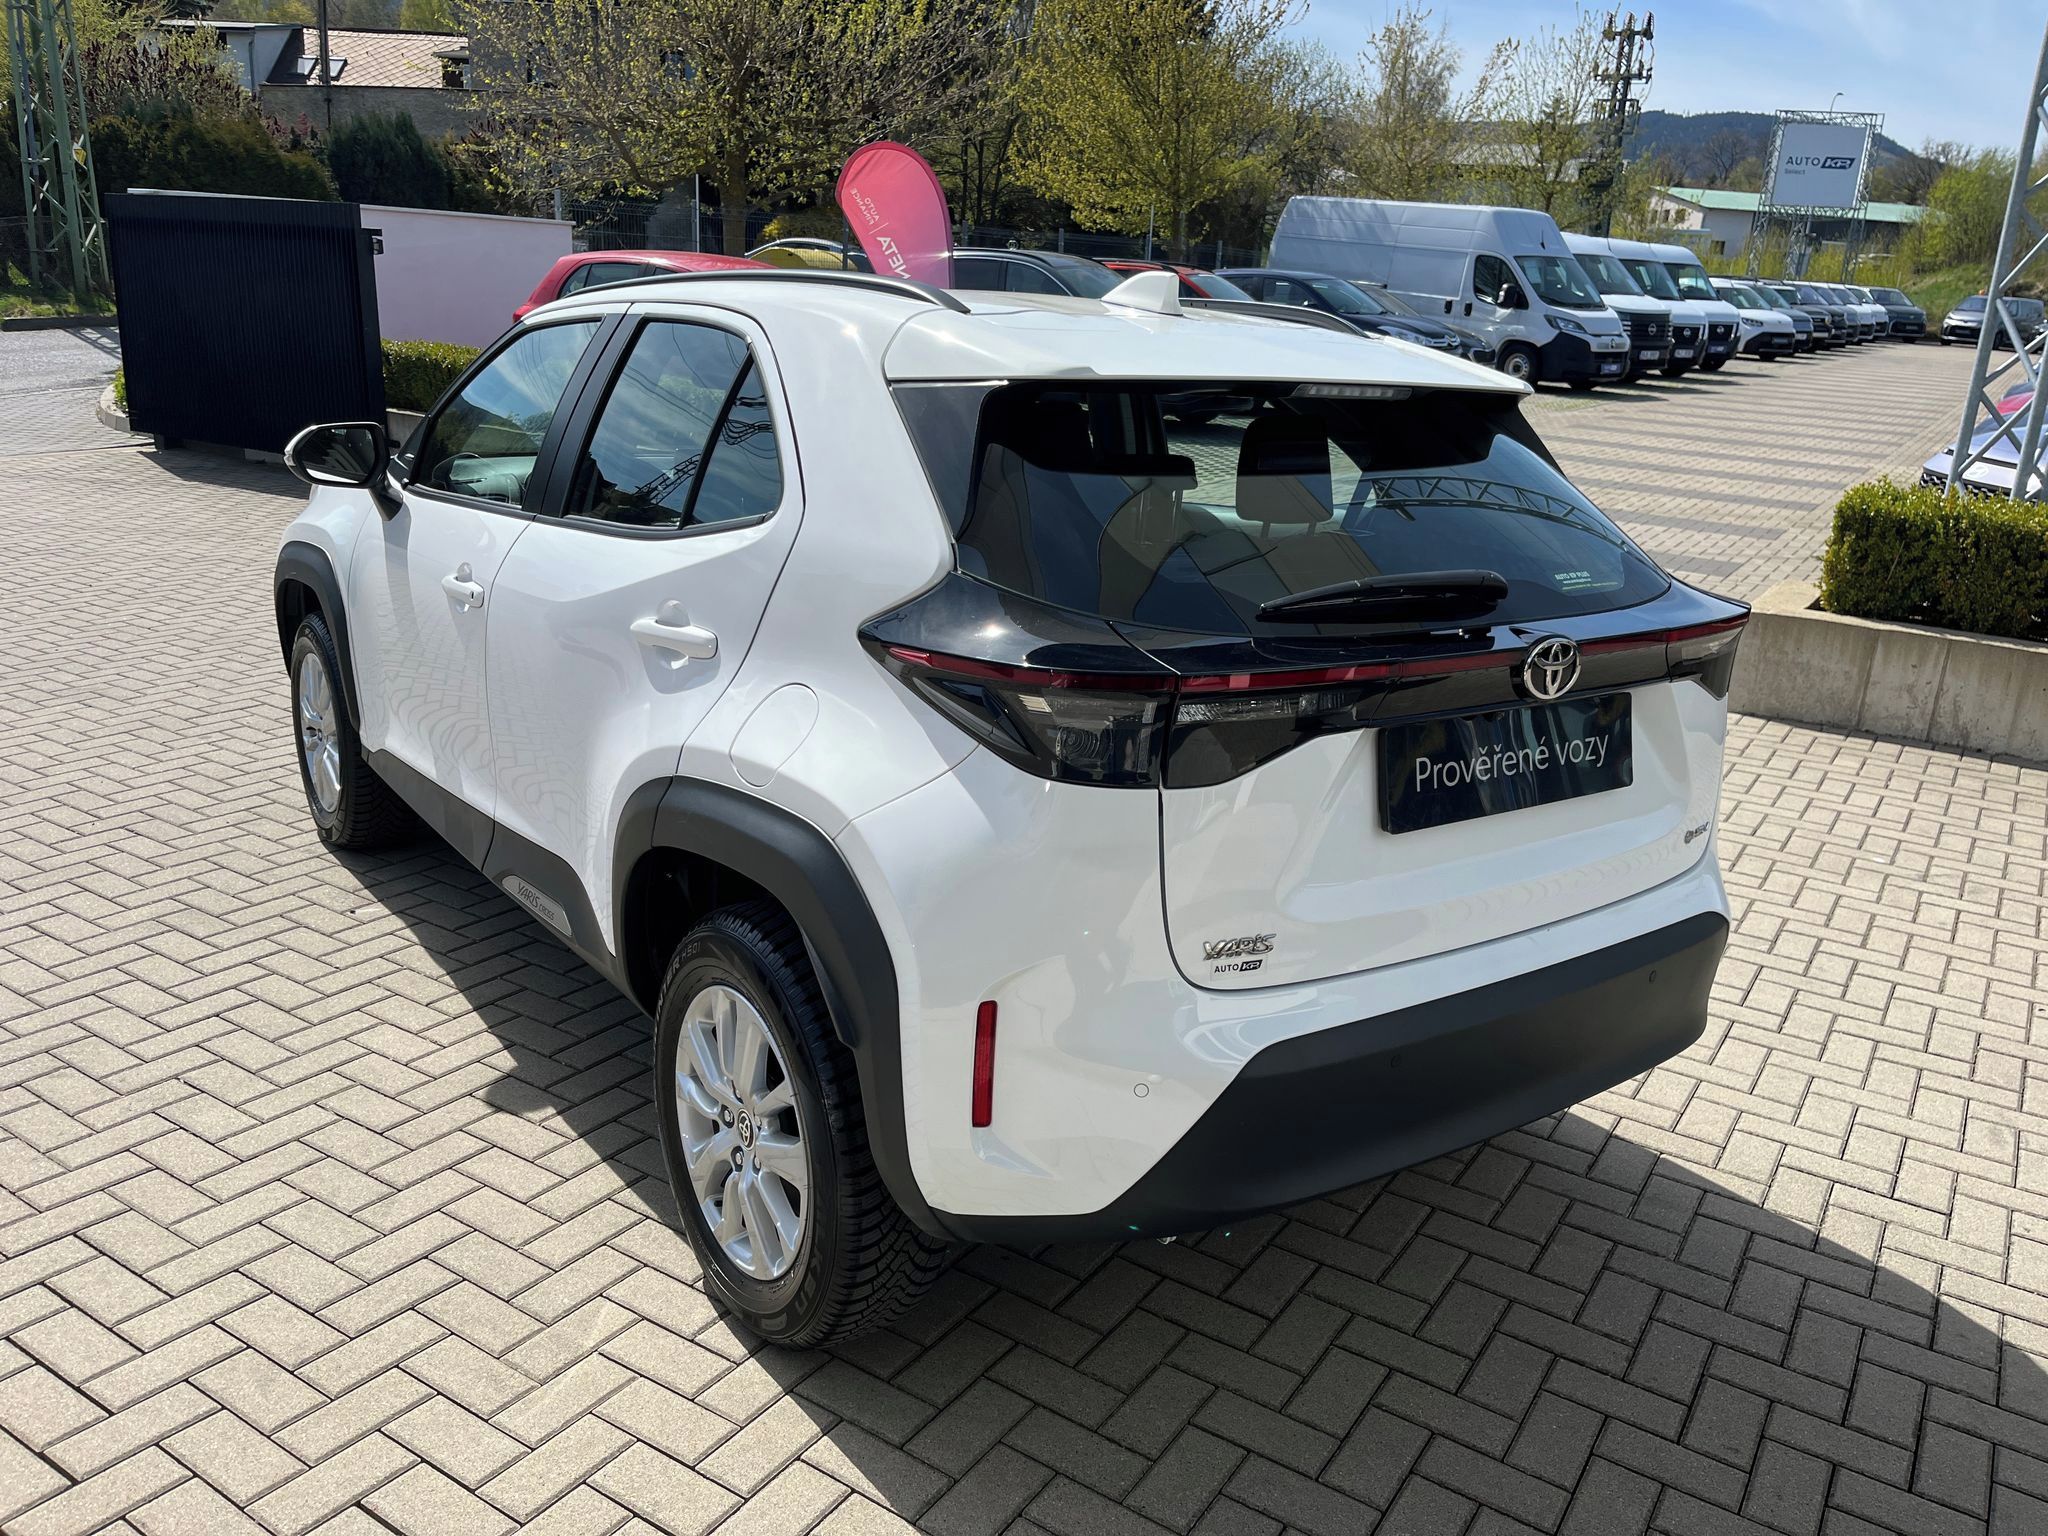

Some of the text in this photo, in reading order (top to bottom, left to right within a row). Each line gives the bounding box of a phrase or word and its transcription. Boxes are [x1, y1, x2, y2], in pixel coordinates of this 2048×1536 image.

[1785, 156, 1820, 166] AUTO
[1415, 734, 1609, 793] Prověřené vozy
[1214, 963, 1239, 974] AUTO
